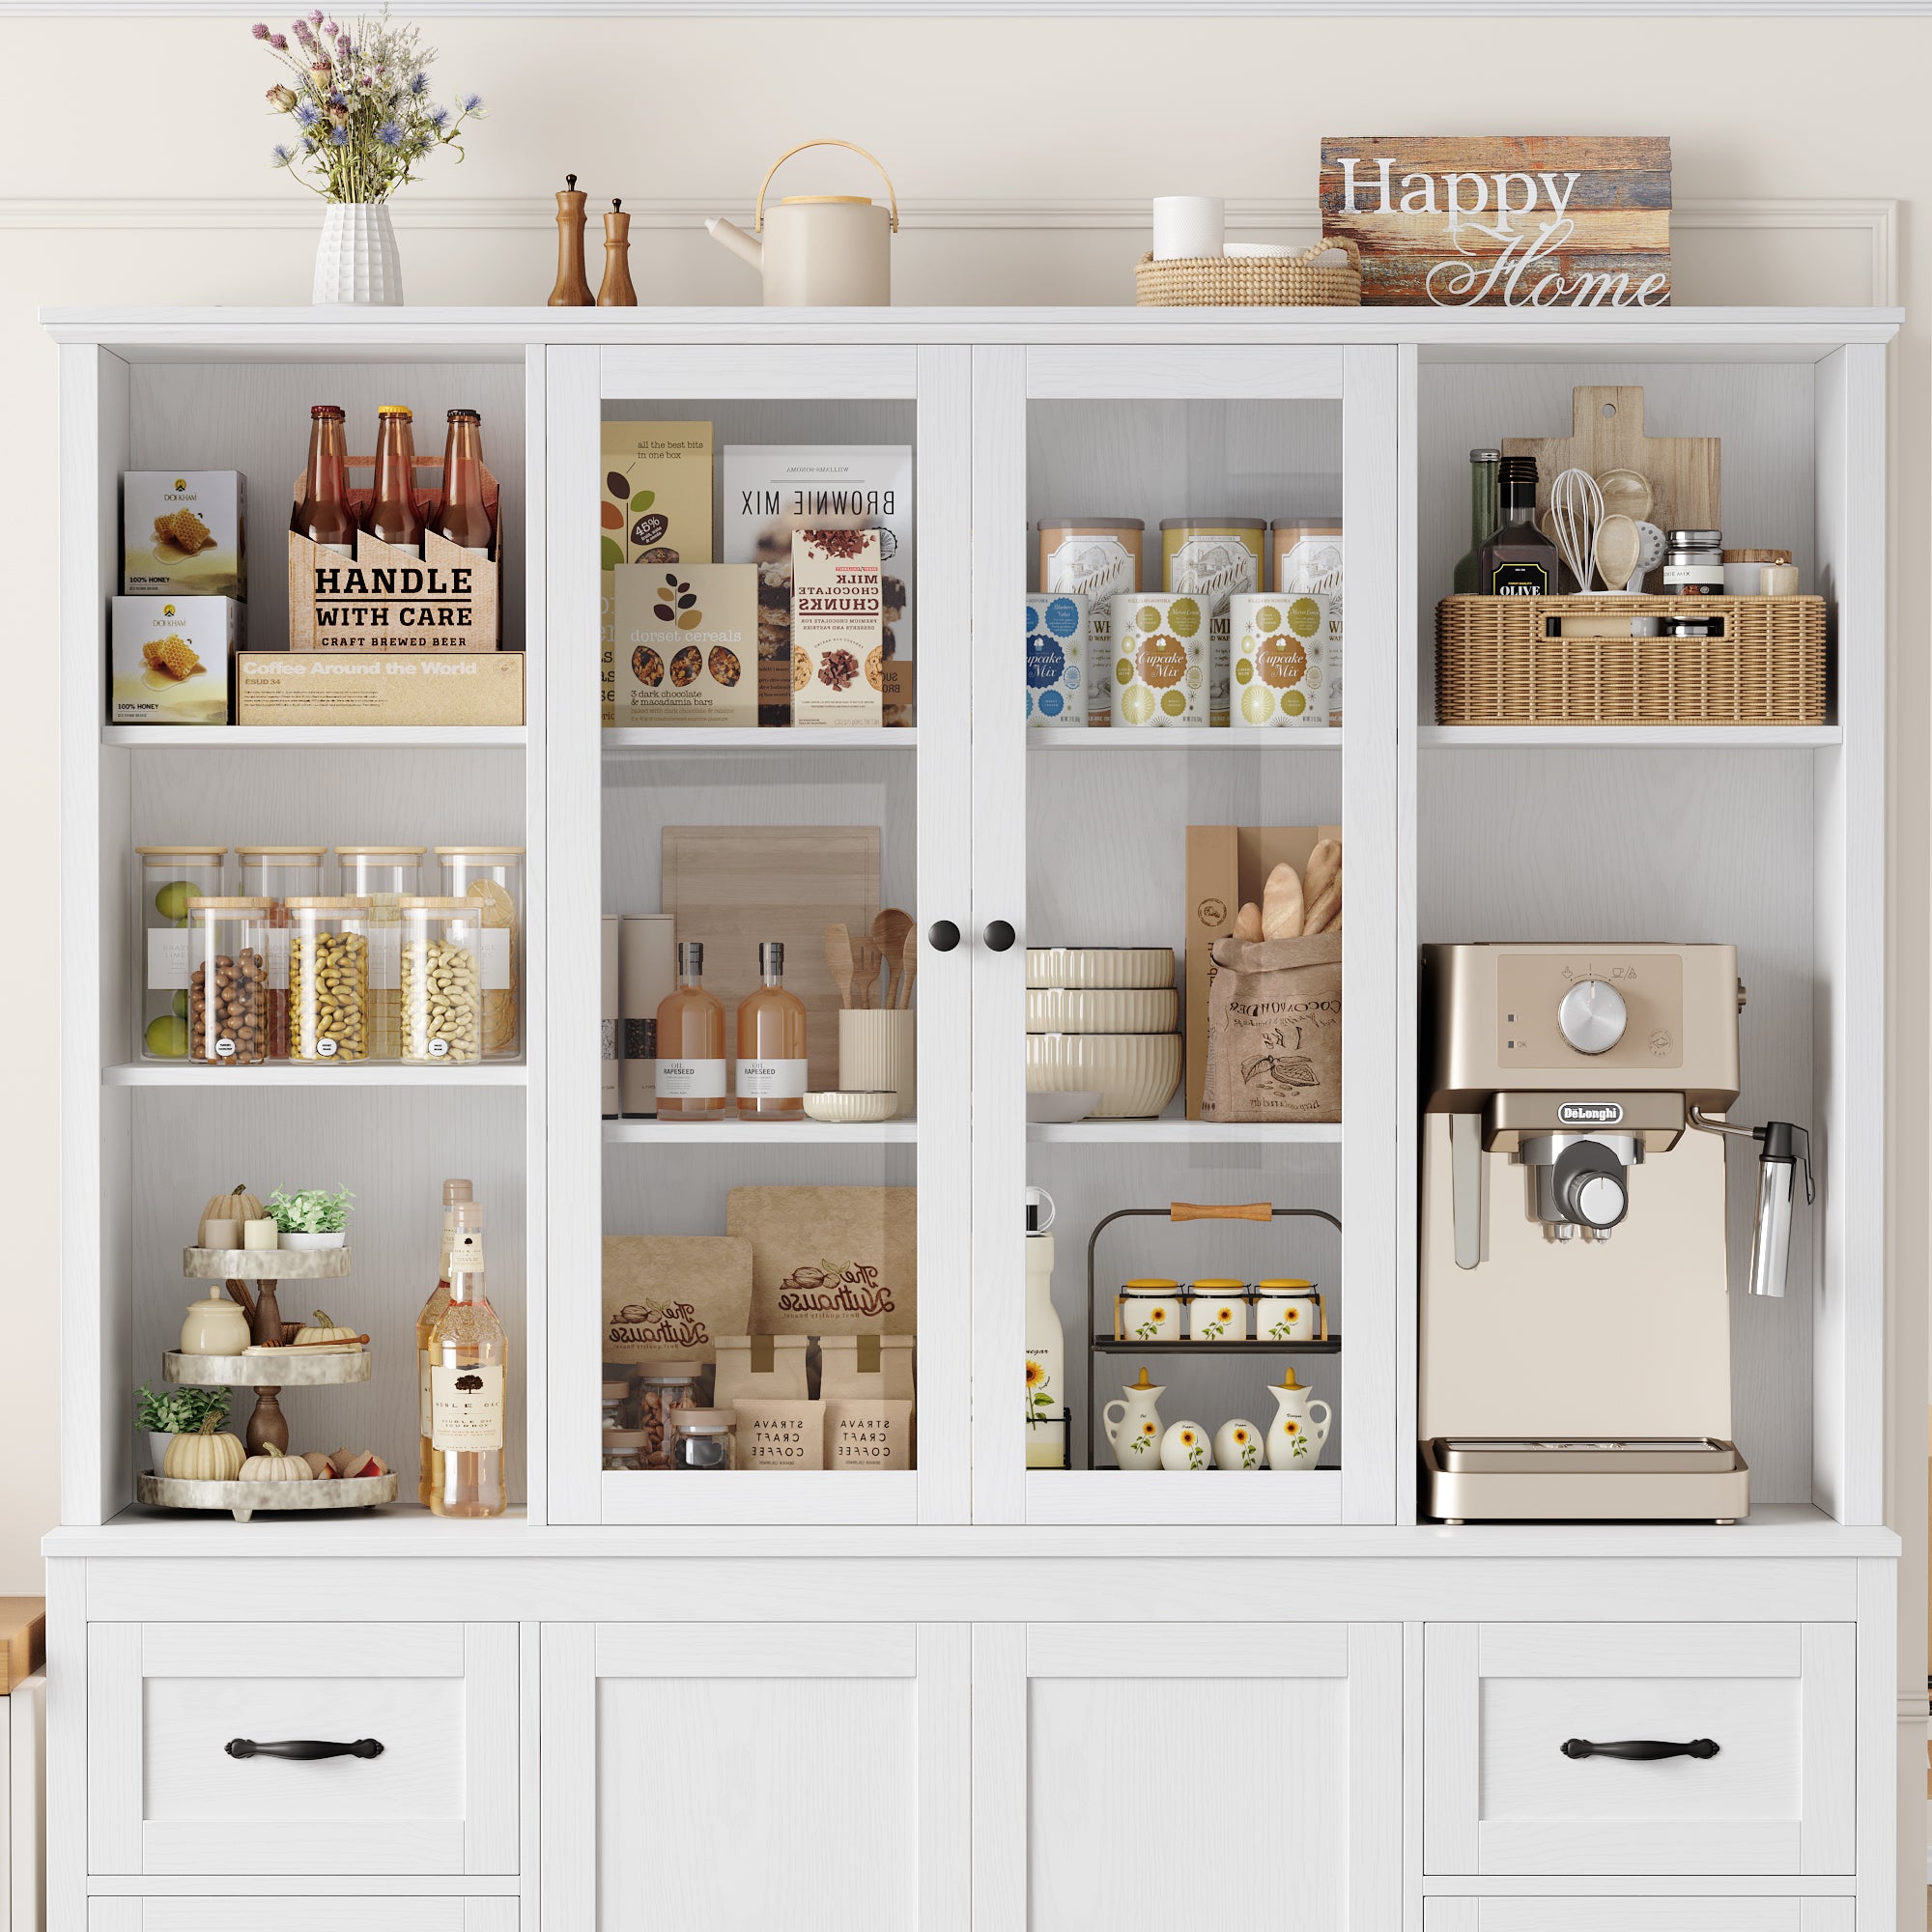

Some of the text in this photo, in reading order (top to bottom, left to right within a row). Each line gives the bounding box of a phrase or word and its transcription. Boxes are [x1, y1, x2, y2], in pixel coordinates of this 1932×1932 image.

[1337, 157, 1581, 233] Happy
[1426, 218, 1671, 307] Home
[638, 440, 704, 449] all the best bits
[638, 451, 647, 459] in
[666, 451, 682, 459] box
[636, 516, 660, 536] 45%
[315, 568, 472, 594] HANDLE
[1500, 586, 1540, 595] OLIVE
[316, 608, 472, 626] WITH CARE
[322, 638, 466, 646] CRAFT BREWED BEER
[630, 629, 681, 642] dorset
[685, 629, 741, 642] cereals
[1138, 651, 1184, 666] Cupcake
[1258, 651, 1304, 666] Cupcake
[243, 661, 477, 675] Coffee Around the World
[1029, 664, 1057, 677] Mix
[1151, 664, 1179, 678] Mix
[1271, 664, 1299, 678] Mix
